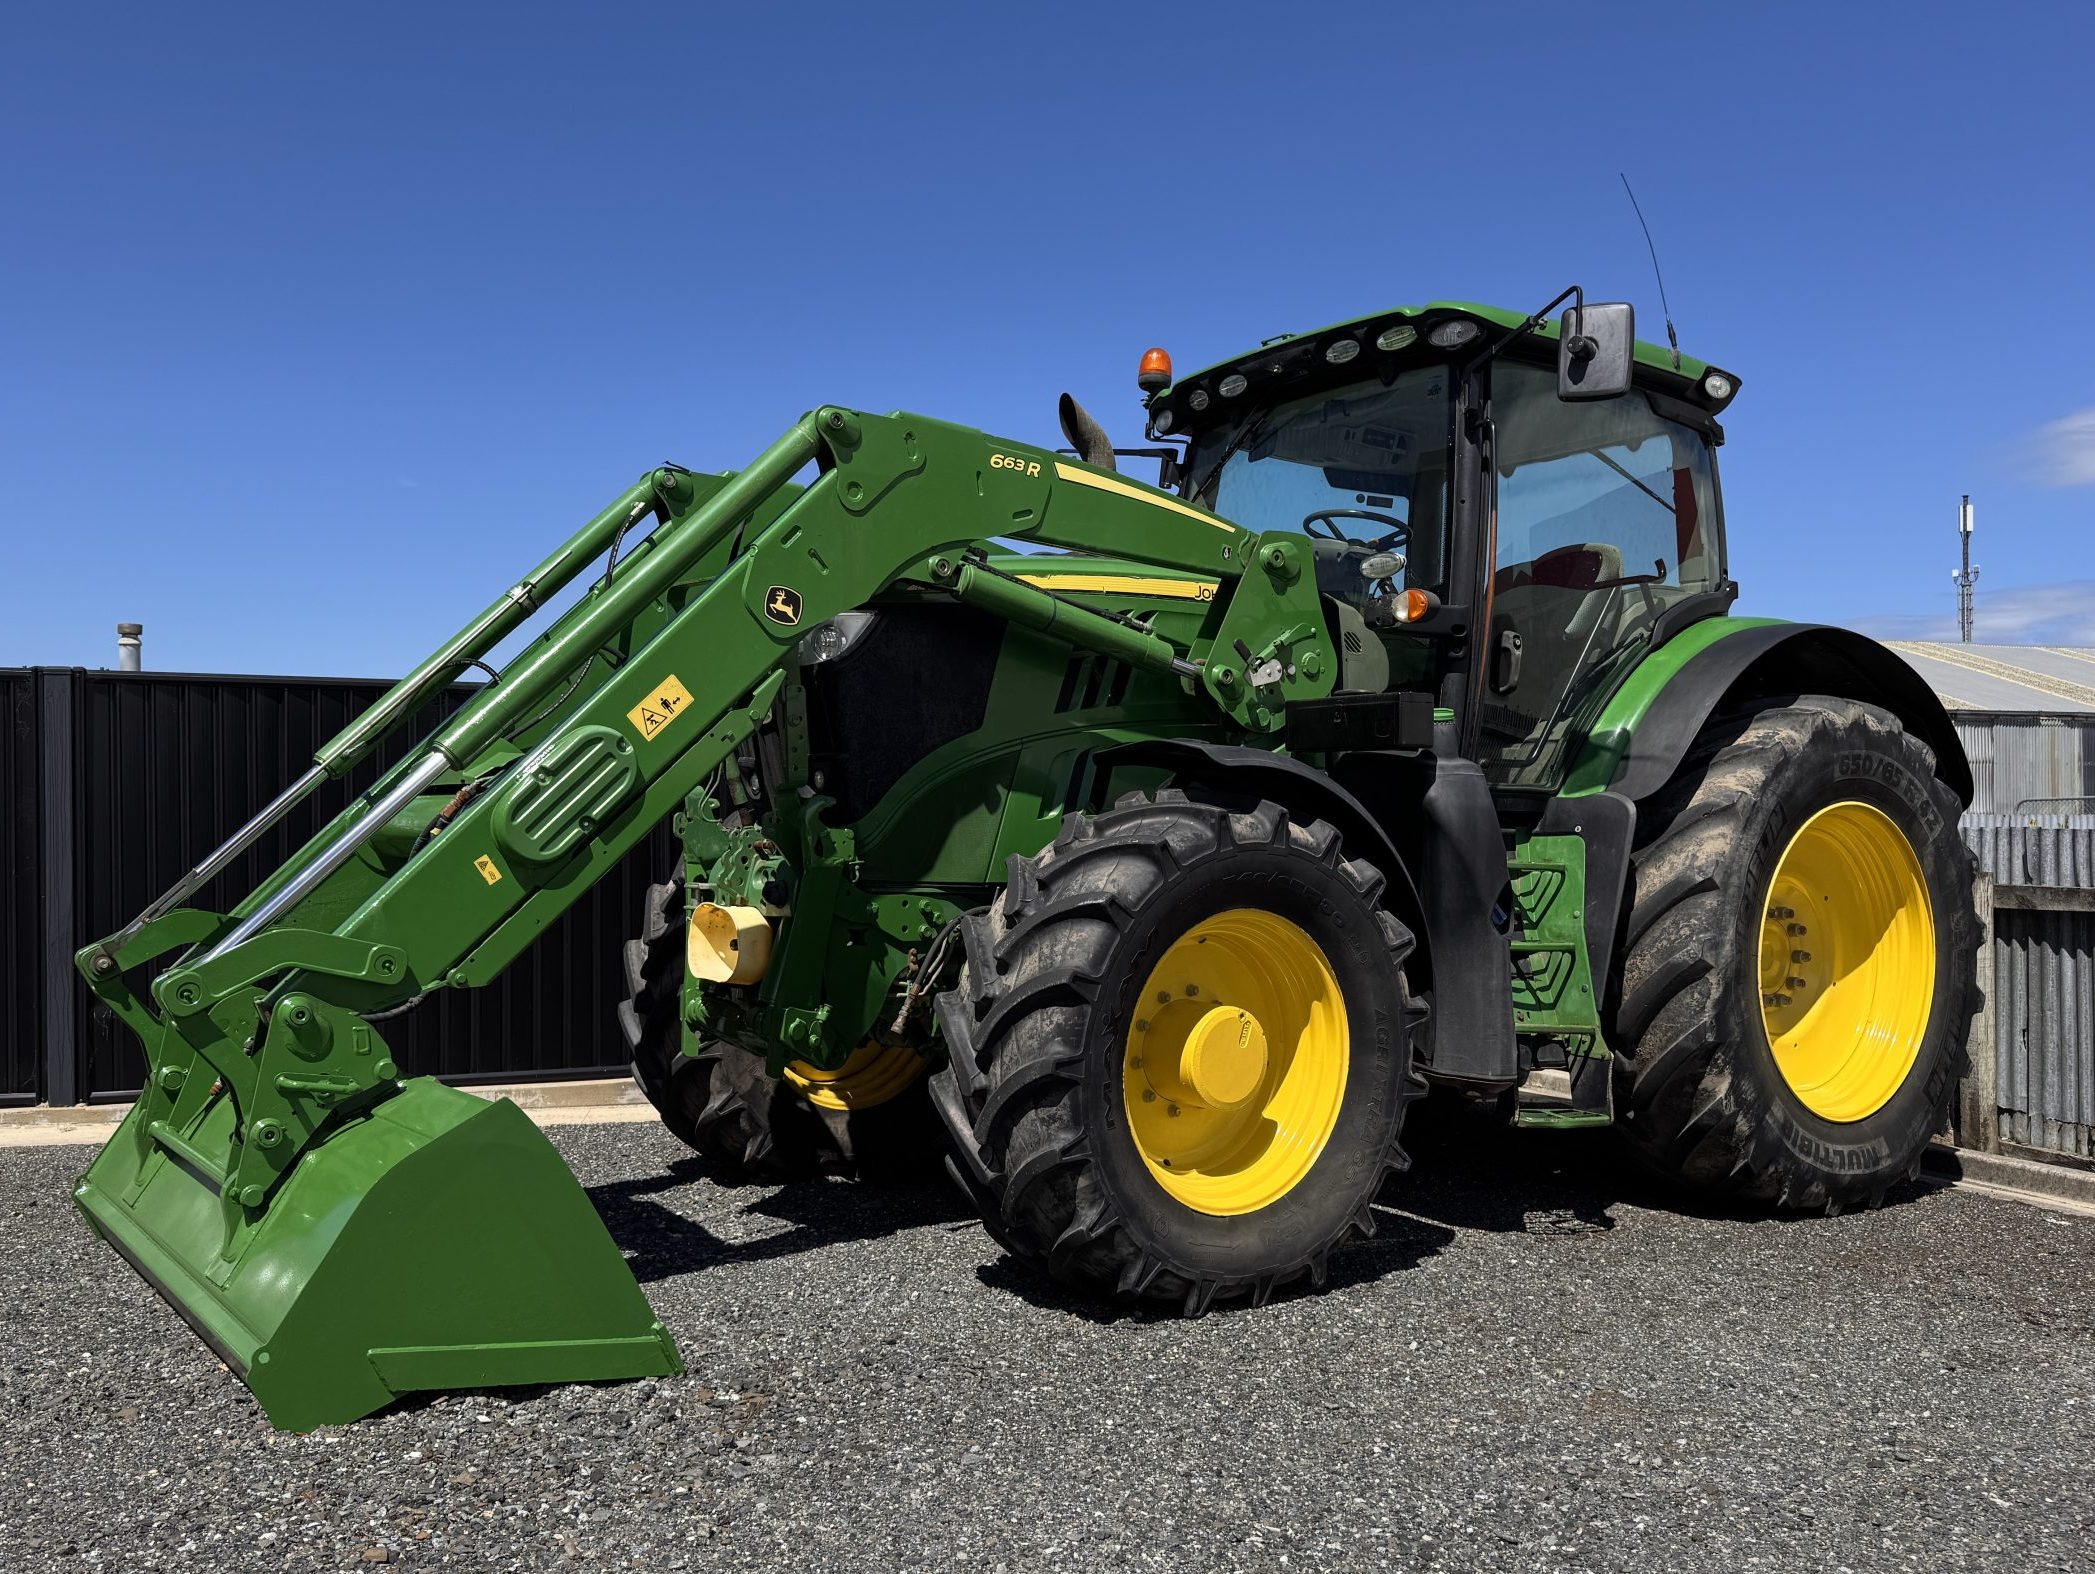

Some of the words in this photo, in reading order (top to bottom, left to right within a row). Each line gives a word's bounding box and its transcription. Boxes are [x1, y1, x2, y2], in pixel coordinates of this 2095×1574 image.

[990, 453, 1025, 471] 663
[1026, 461, 1042, 478] R
[1839, 753, 1903, 787] 650/65
